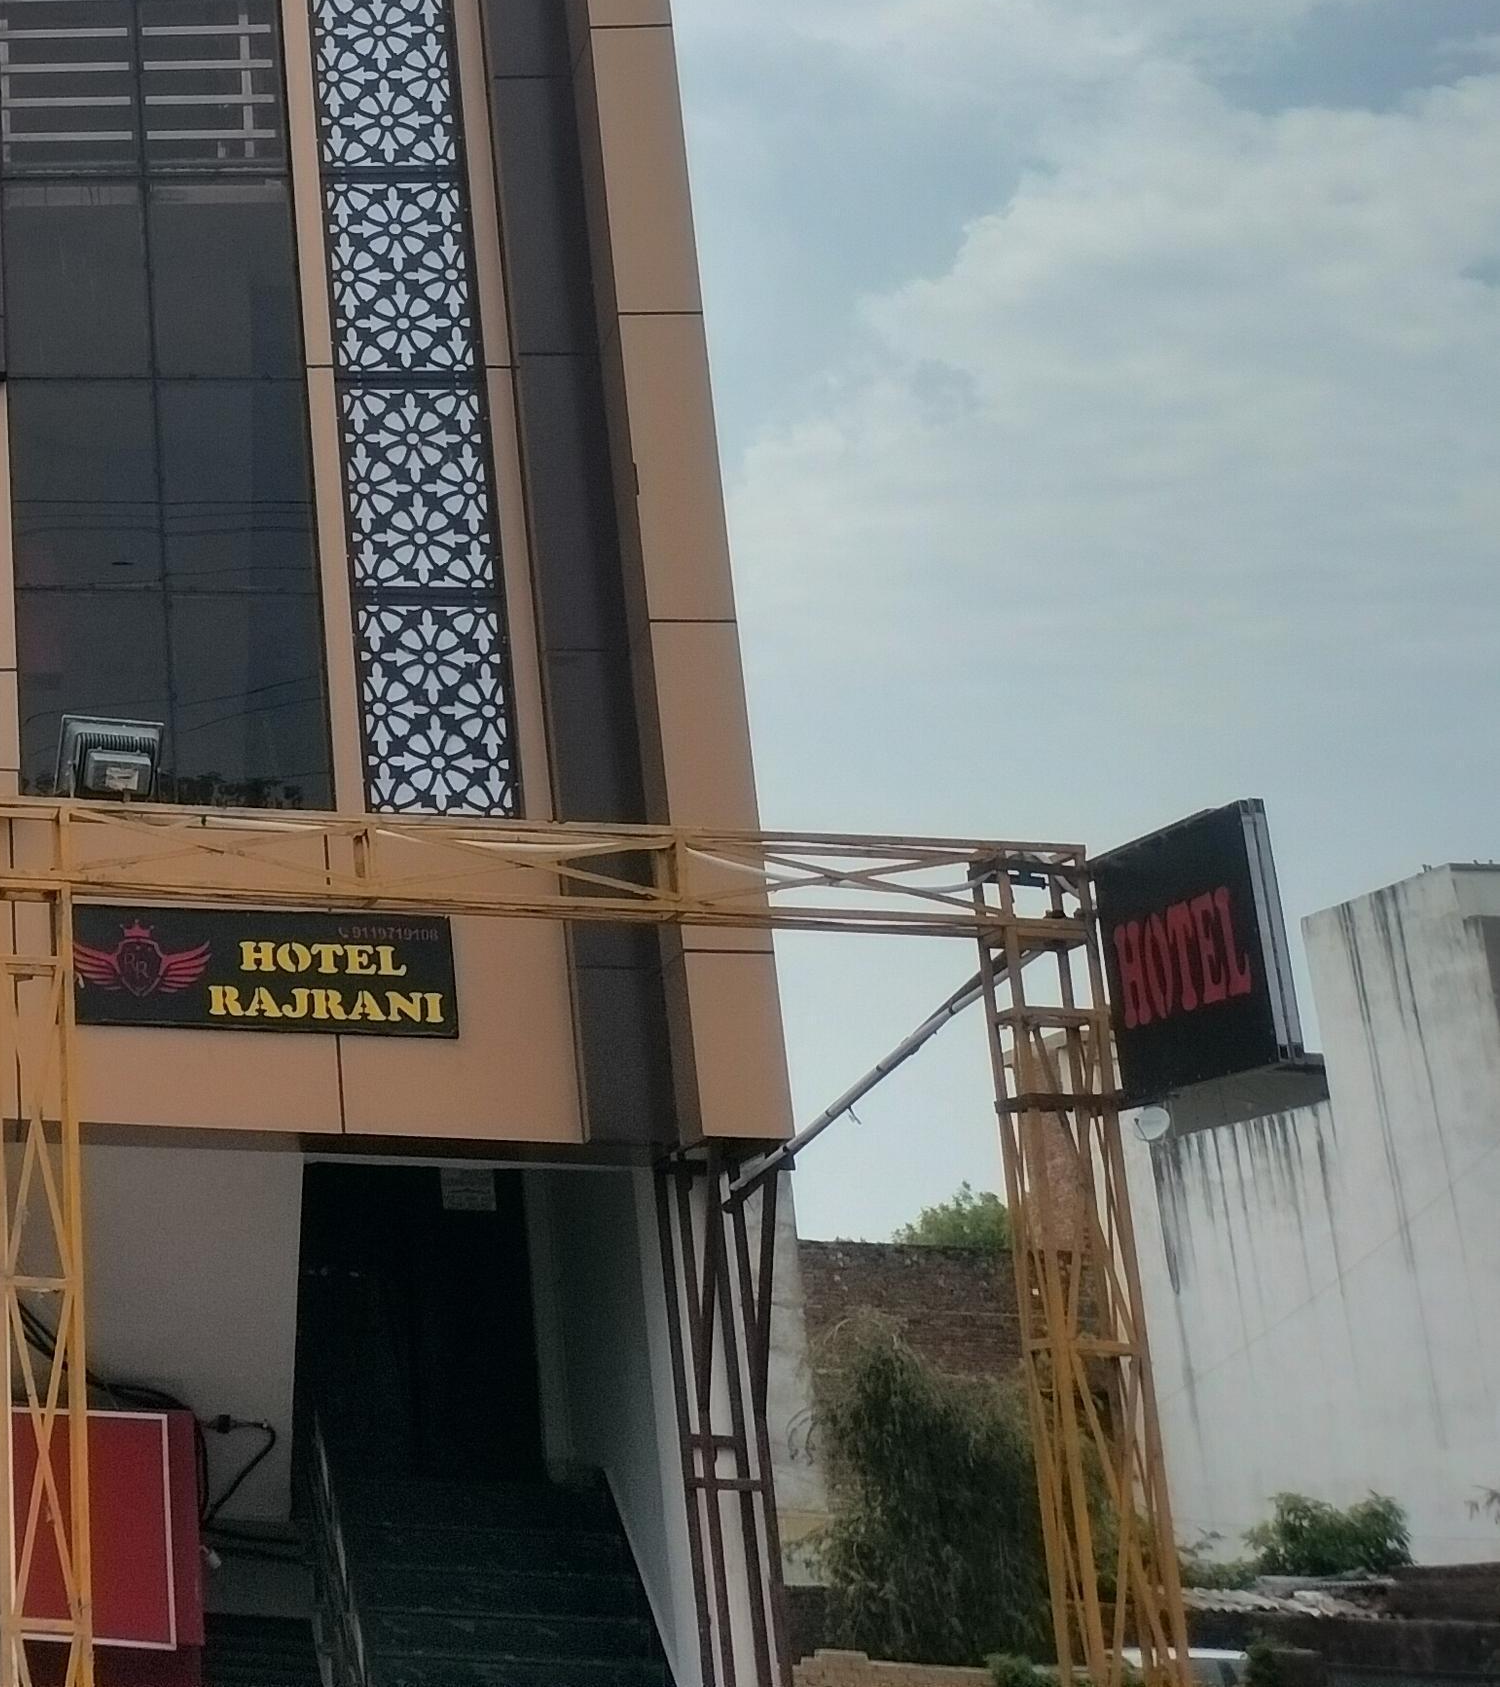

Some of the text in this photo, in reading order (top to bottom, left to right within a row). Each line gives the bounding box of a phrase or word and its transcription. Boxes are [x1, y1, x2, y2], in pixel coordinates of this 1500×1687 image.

[238, 940, 408, 977] HOTEL
[1113, 886, 1252, 1029] HOTEL
[207, 985, 445, 1024] RAJRANI
